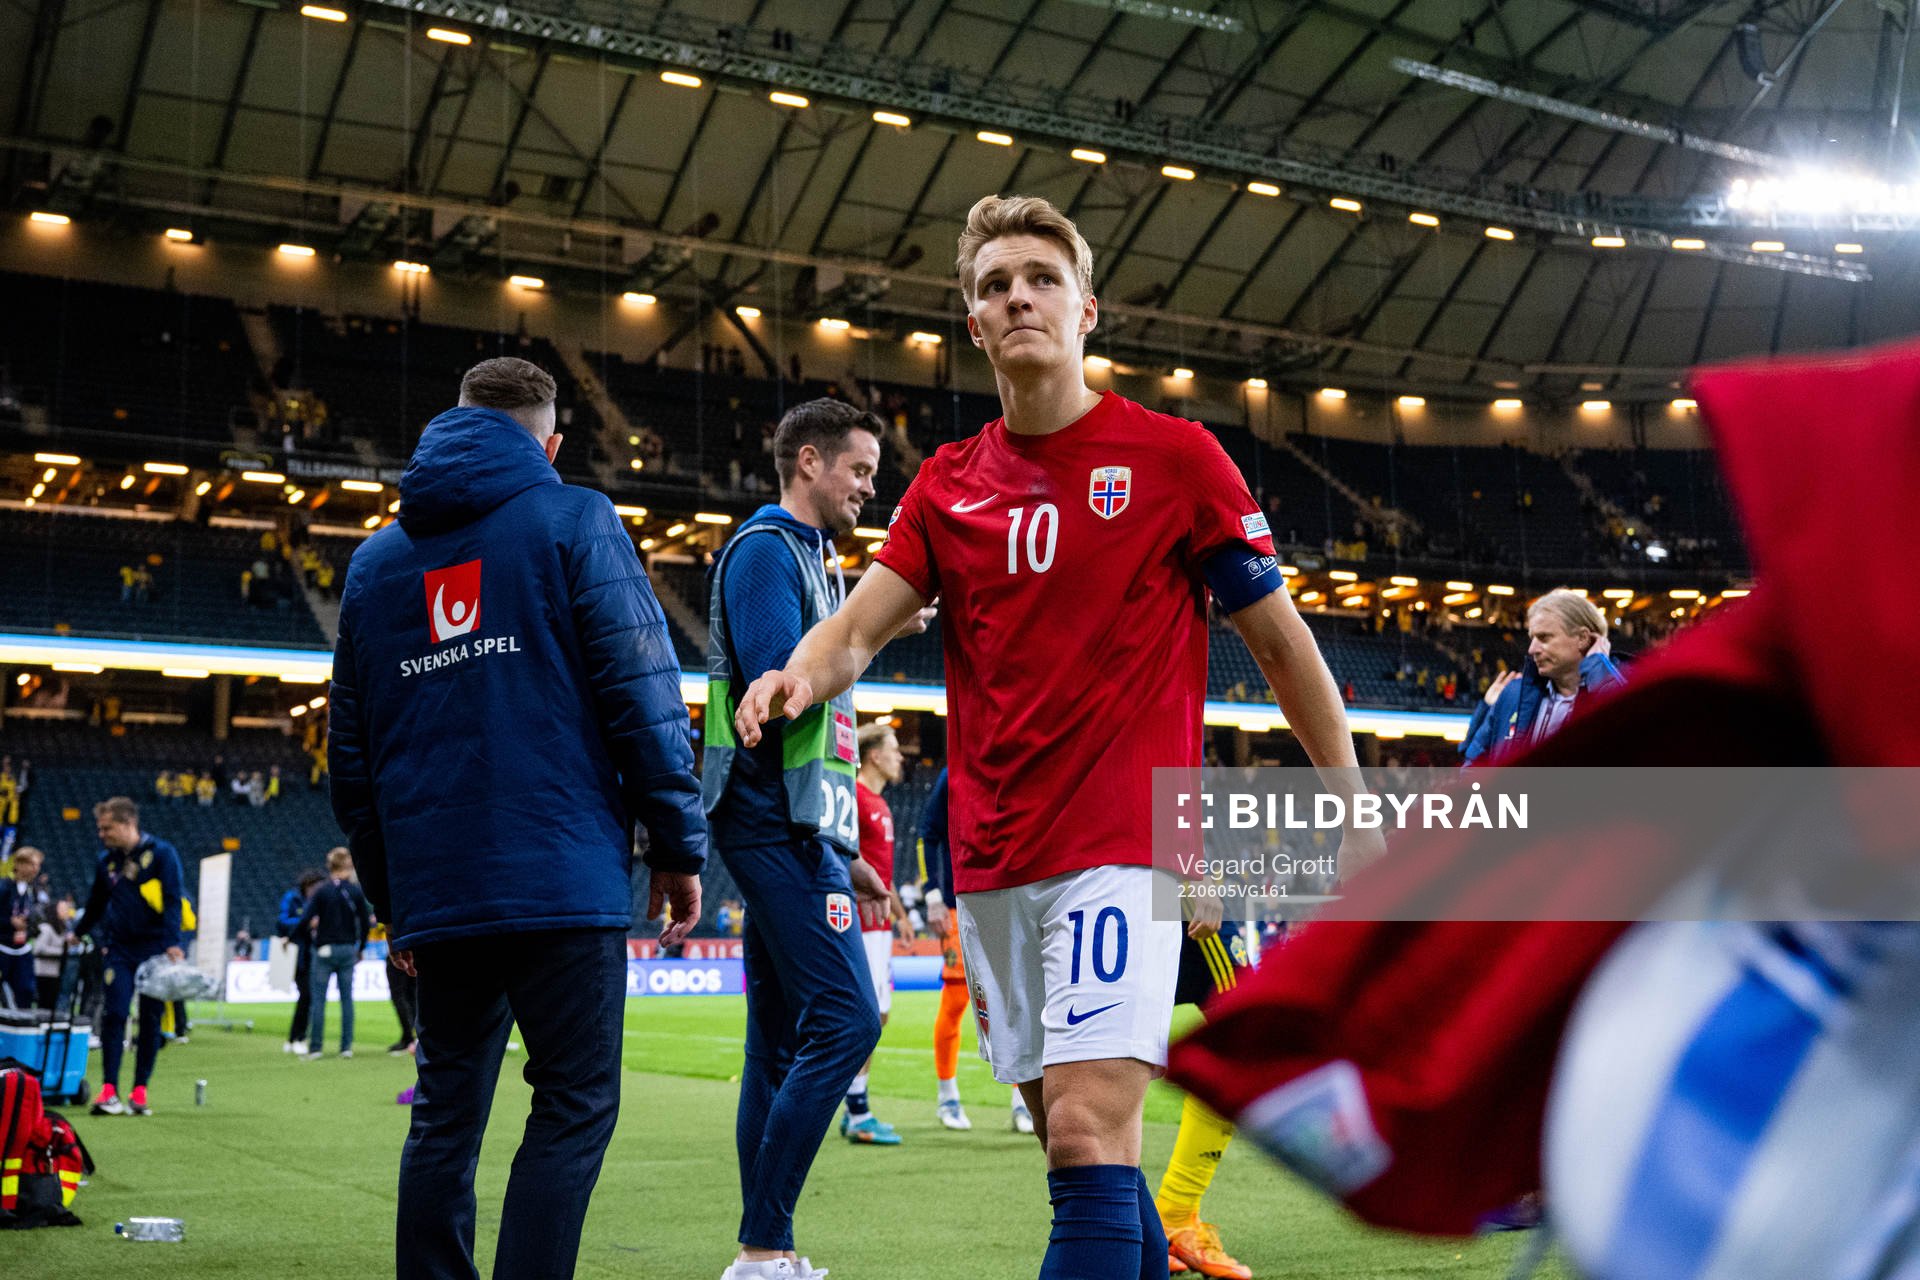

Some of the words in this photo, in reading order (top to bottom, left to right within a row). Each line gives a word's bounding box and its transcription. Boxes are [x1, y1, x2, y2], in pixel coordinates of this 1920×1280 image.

[1007, 503, 1059, 575] 10
[399, 643, 470, 677] SVENSKA
[473, 636, 521, 657] SPEL
[1068, 906, 1128, 984] 10
[649, 968, 722, 993] OBOS
